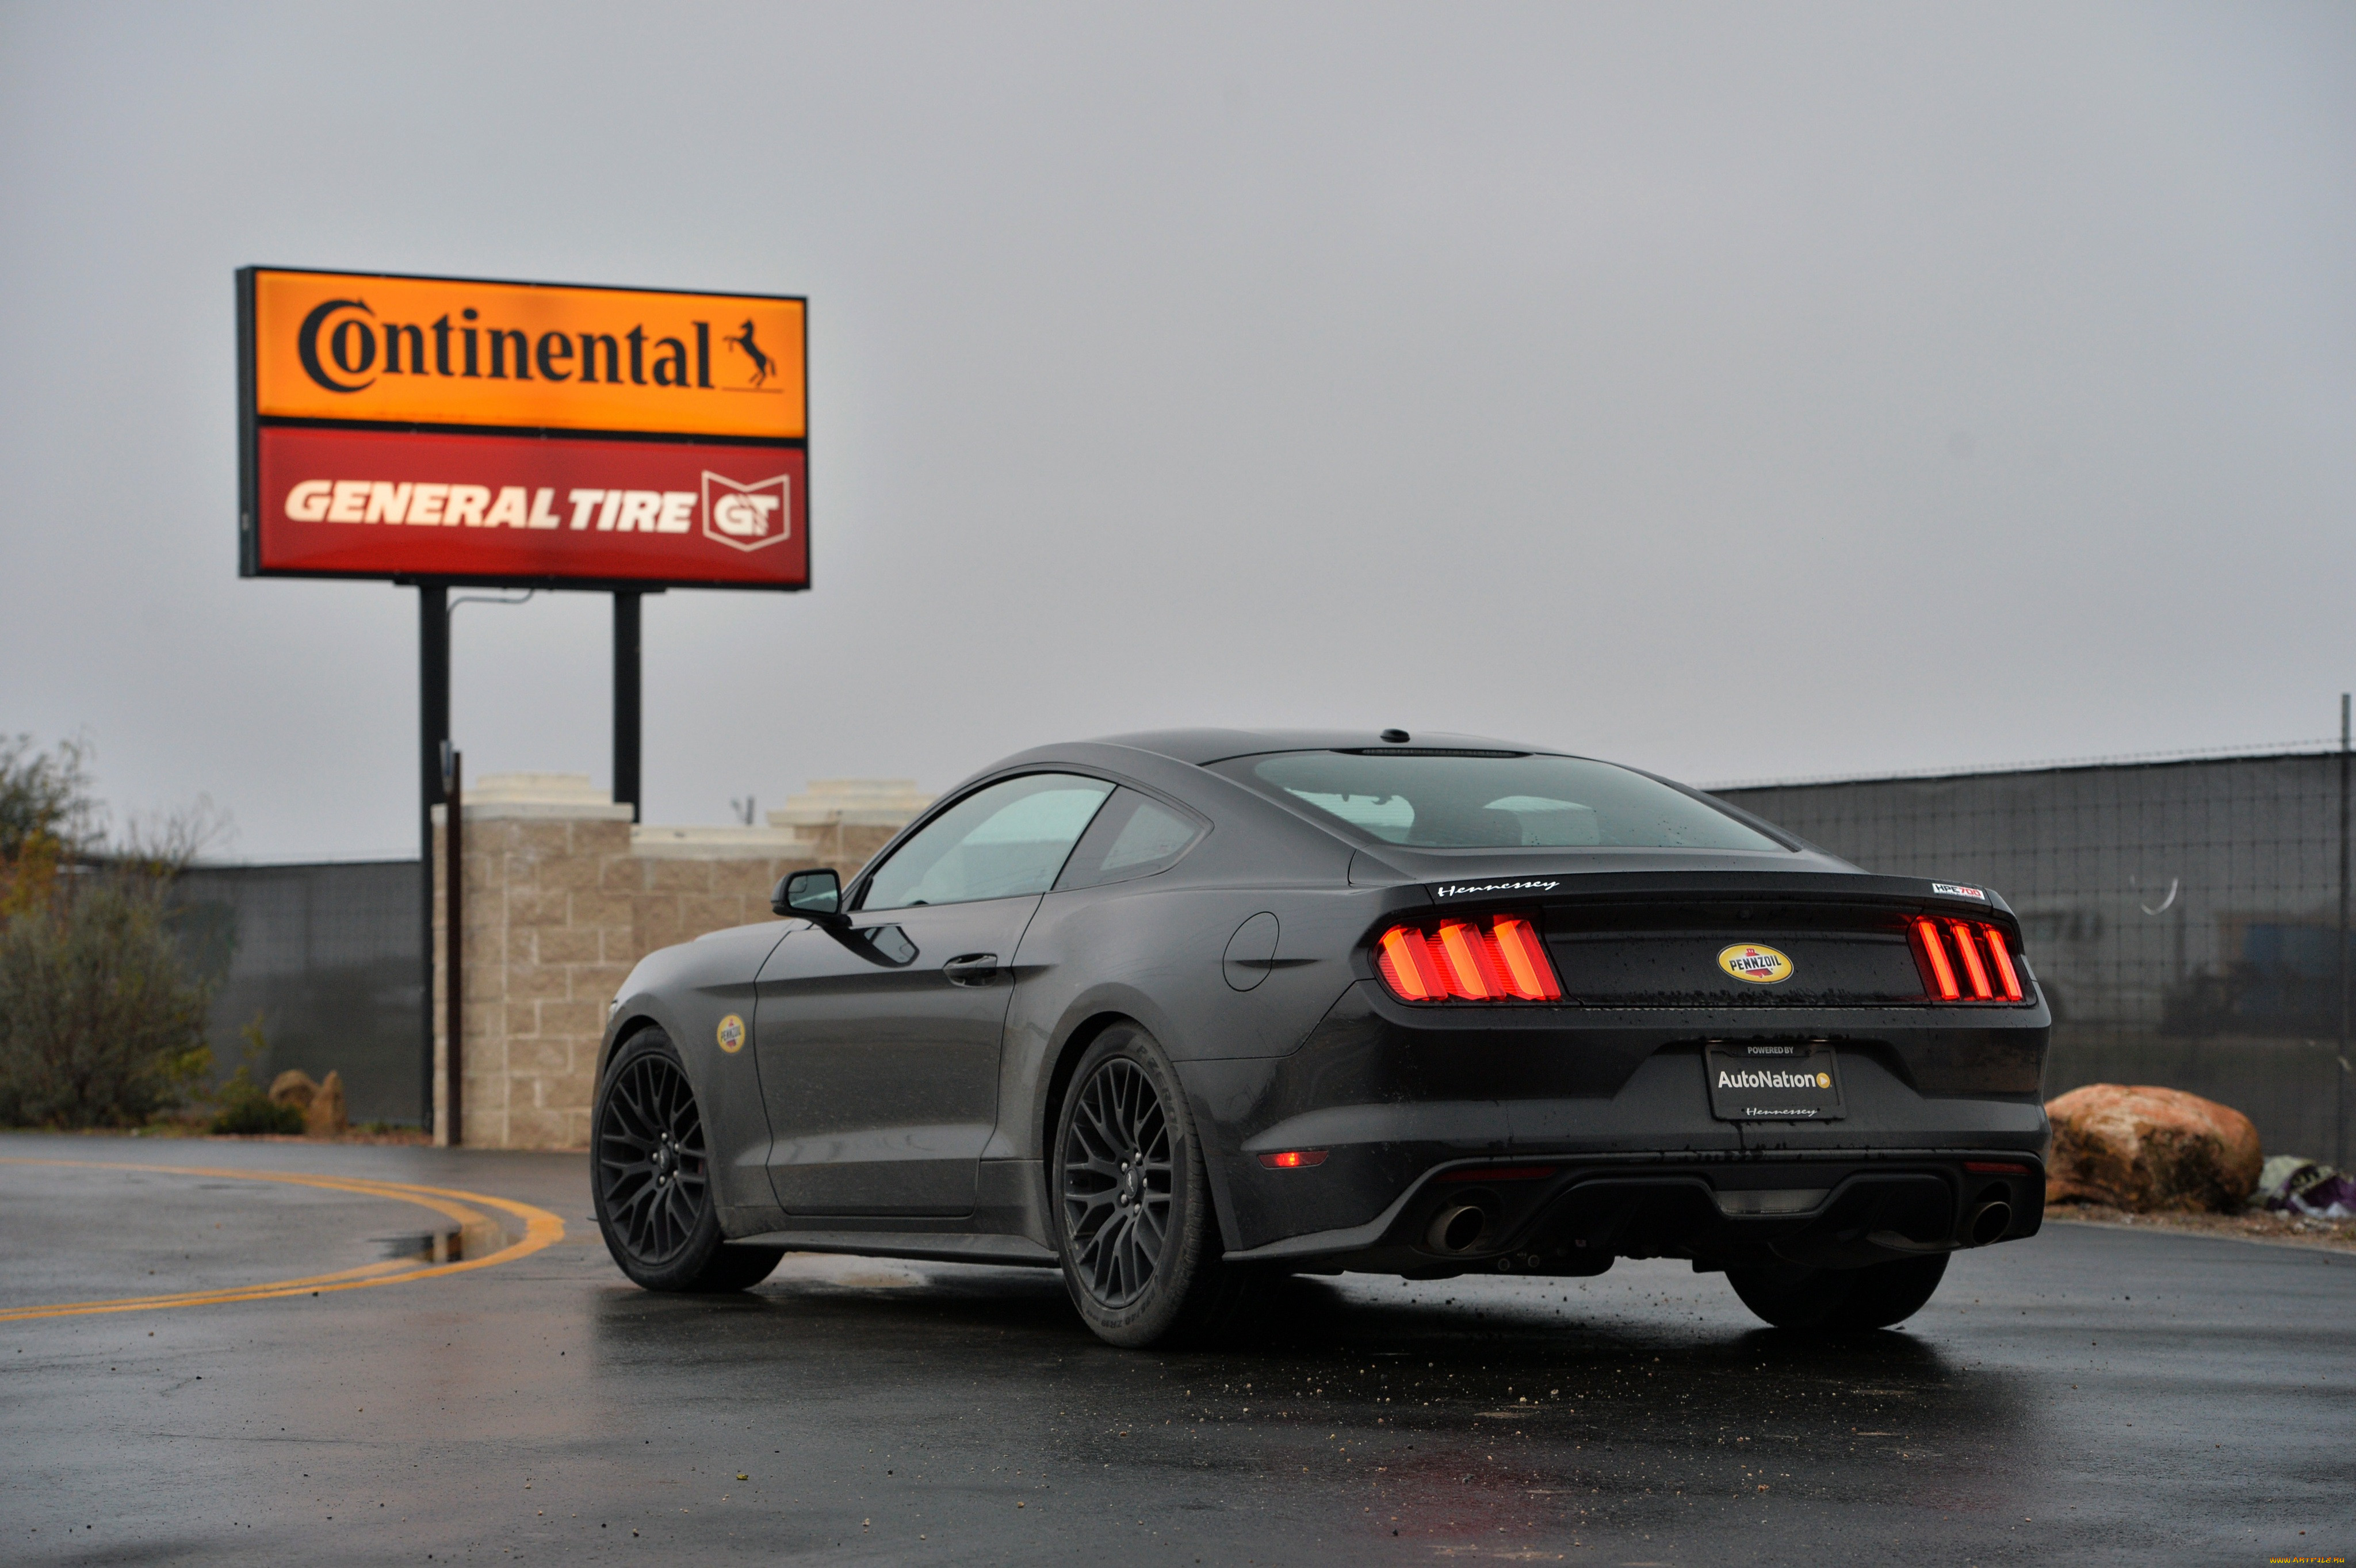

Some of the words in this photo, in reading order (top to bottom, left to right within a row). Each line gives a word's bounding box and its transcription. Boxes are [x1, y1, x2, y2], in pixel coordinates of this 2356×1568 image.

[297, 298, 715, 393] Continental
[285, 480, 561, 529] GENERAL
[568, 488, 698, 533] TIRE
[713, 493, 780, 536] GT
[1438, 881, 1560, 897] Hennessey
[1935, 885, 1981, 896] HPE700
[1729, 955, 1781, 972] PENNZOIL
[1718, 1070, 1816, 1088] AutoNation
[1746, 1107, 1818, 1117] Hennessey
